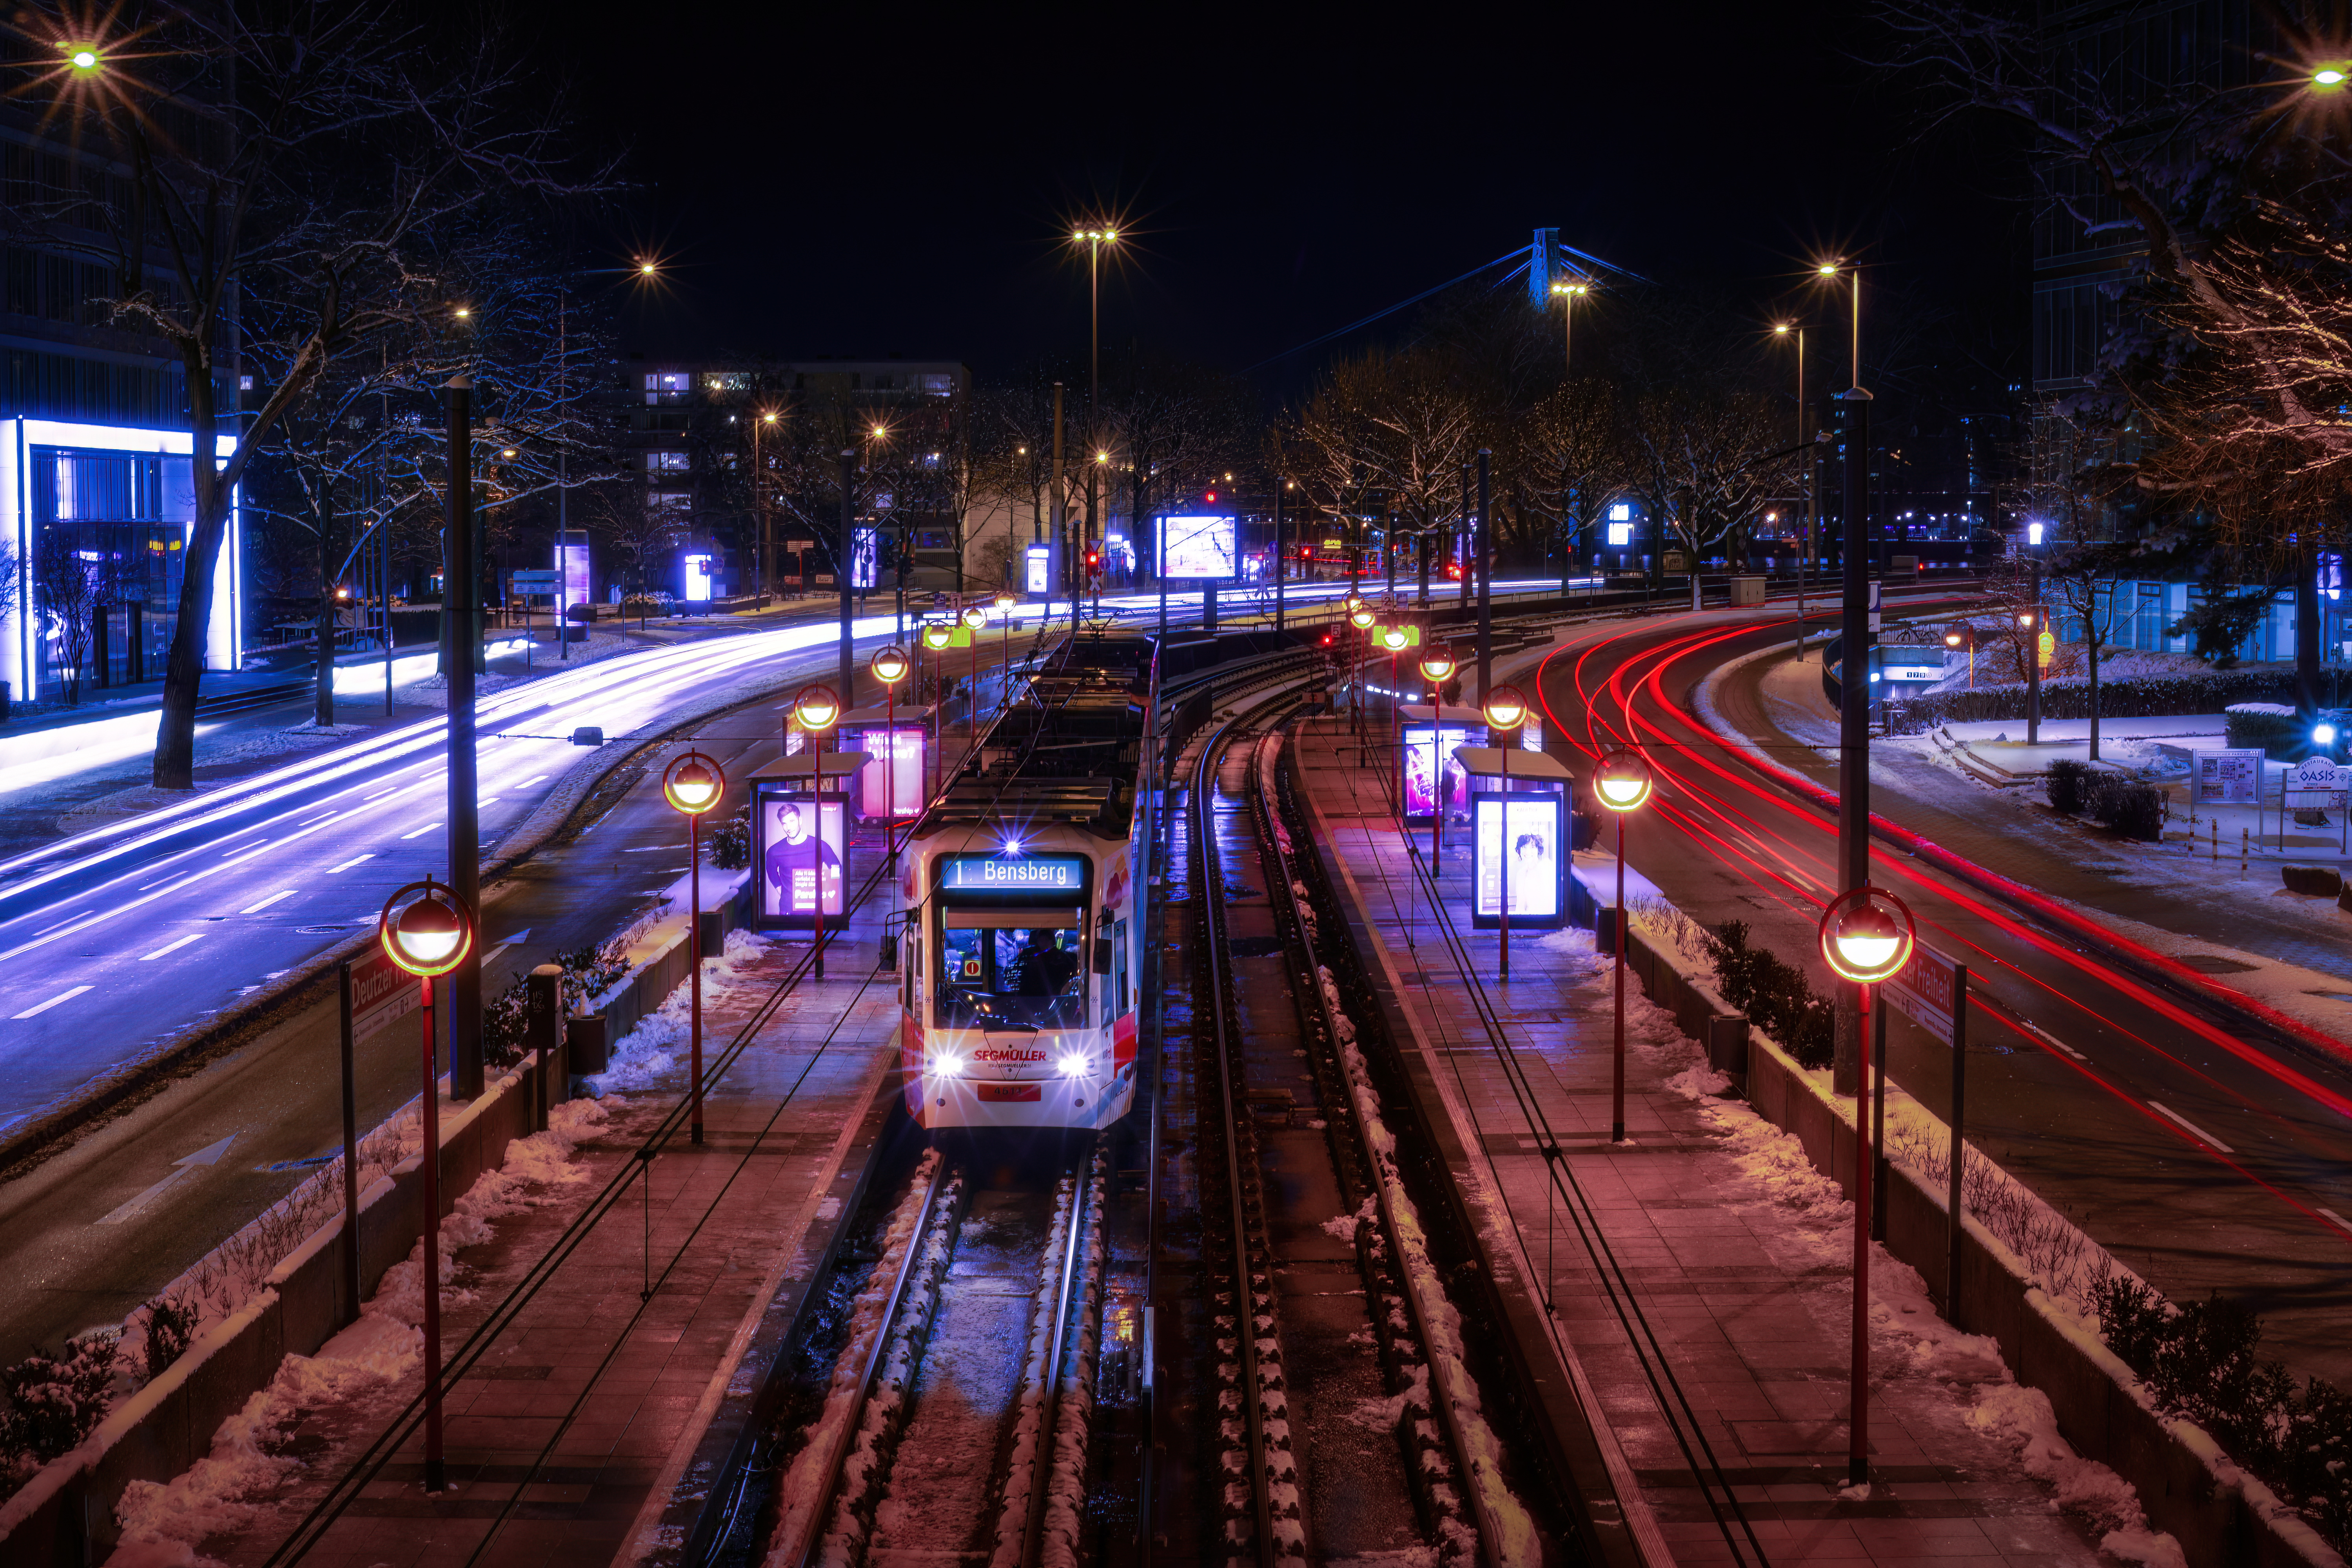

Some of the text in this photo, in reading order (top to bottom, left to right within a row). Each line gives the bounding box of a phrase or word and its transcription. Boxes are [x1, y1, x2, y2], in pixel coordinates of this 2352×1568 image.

[953, 598, 958, 607] 1
[1384, 597, 1391, 606] 2
[1334, 627, 1339, 636] 5
[2301, 759, 2335, 769] RESTAURANT
[2300, 770, 2336, 781] OASIS
[955, 860, 1066, 885] 1 Bensberg
[795, 889, 827, 899] Parshp
[352, 967, 392, 1009] Deutzer
[1918, 958, 1950, 1008] Freiheit
[974, 1049, 1046, 1061] SEGMÜLLER
